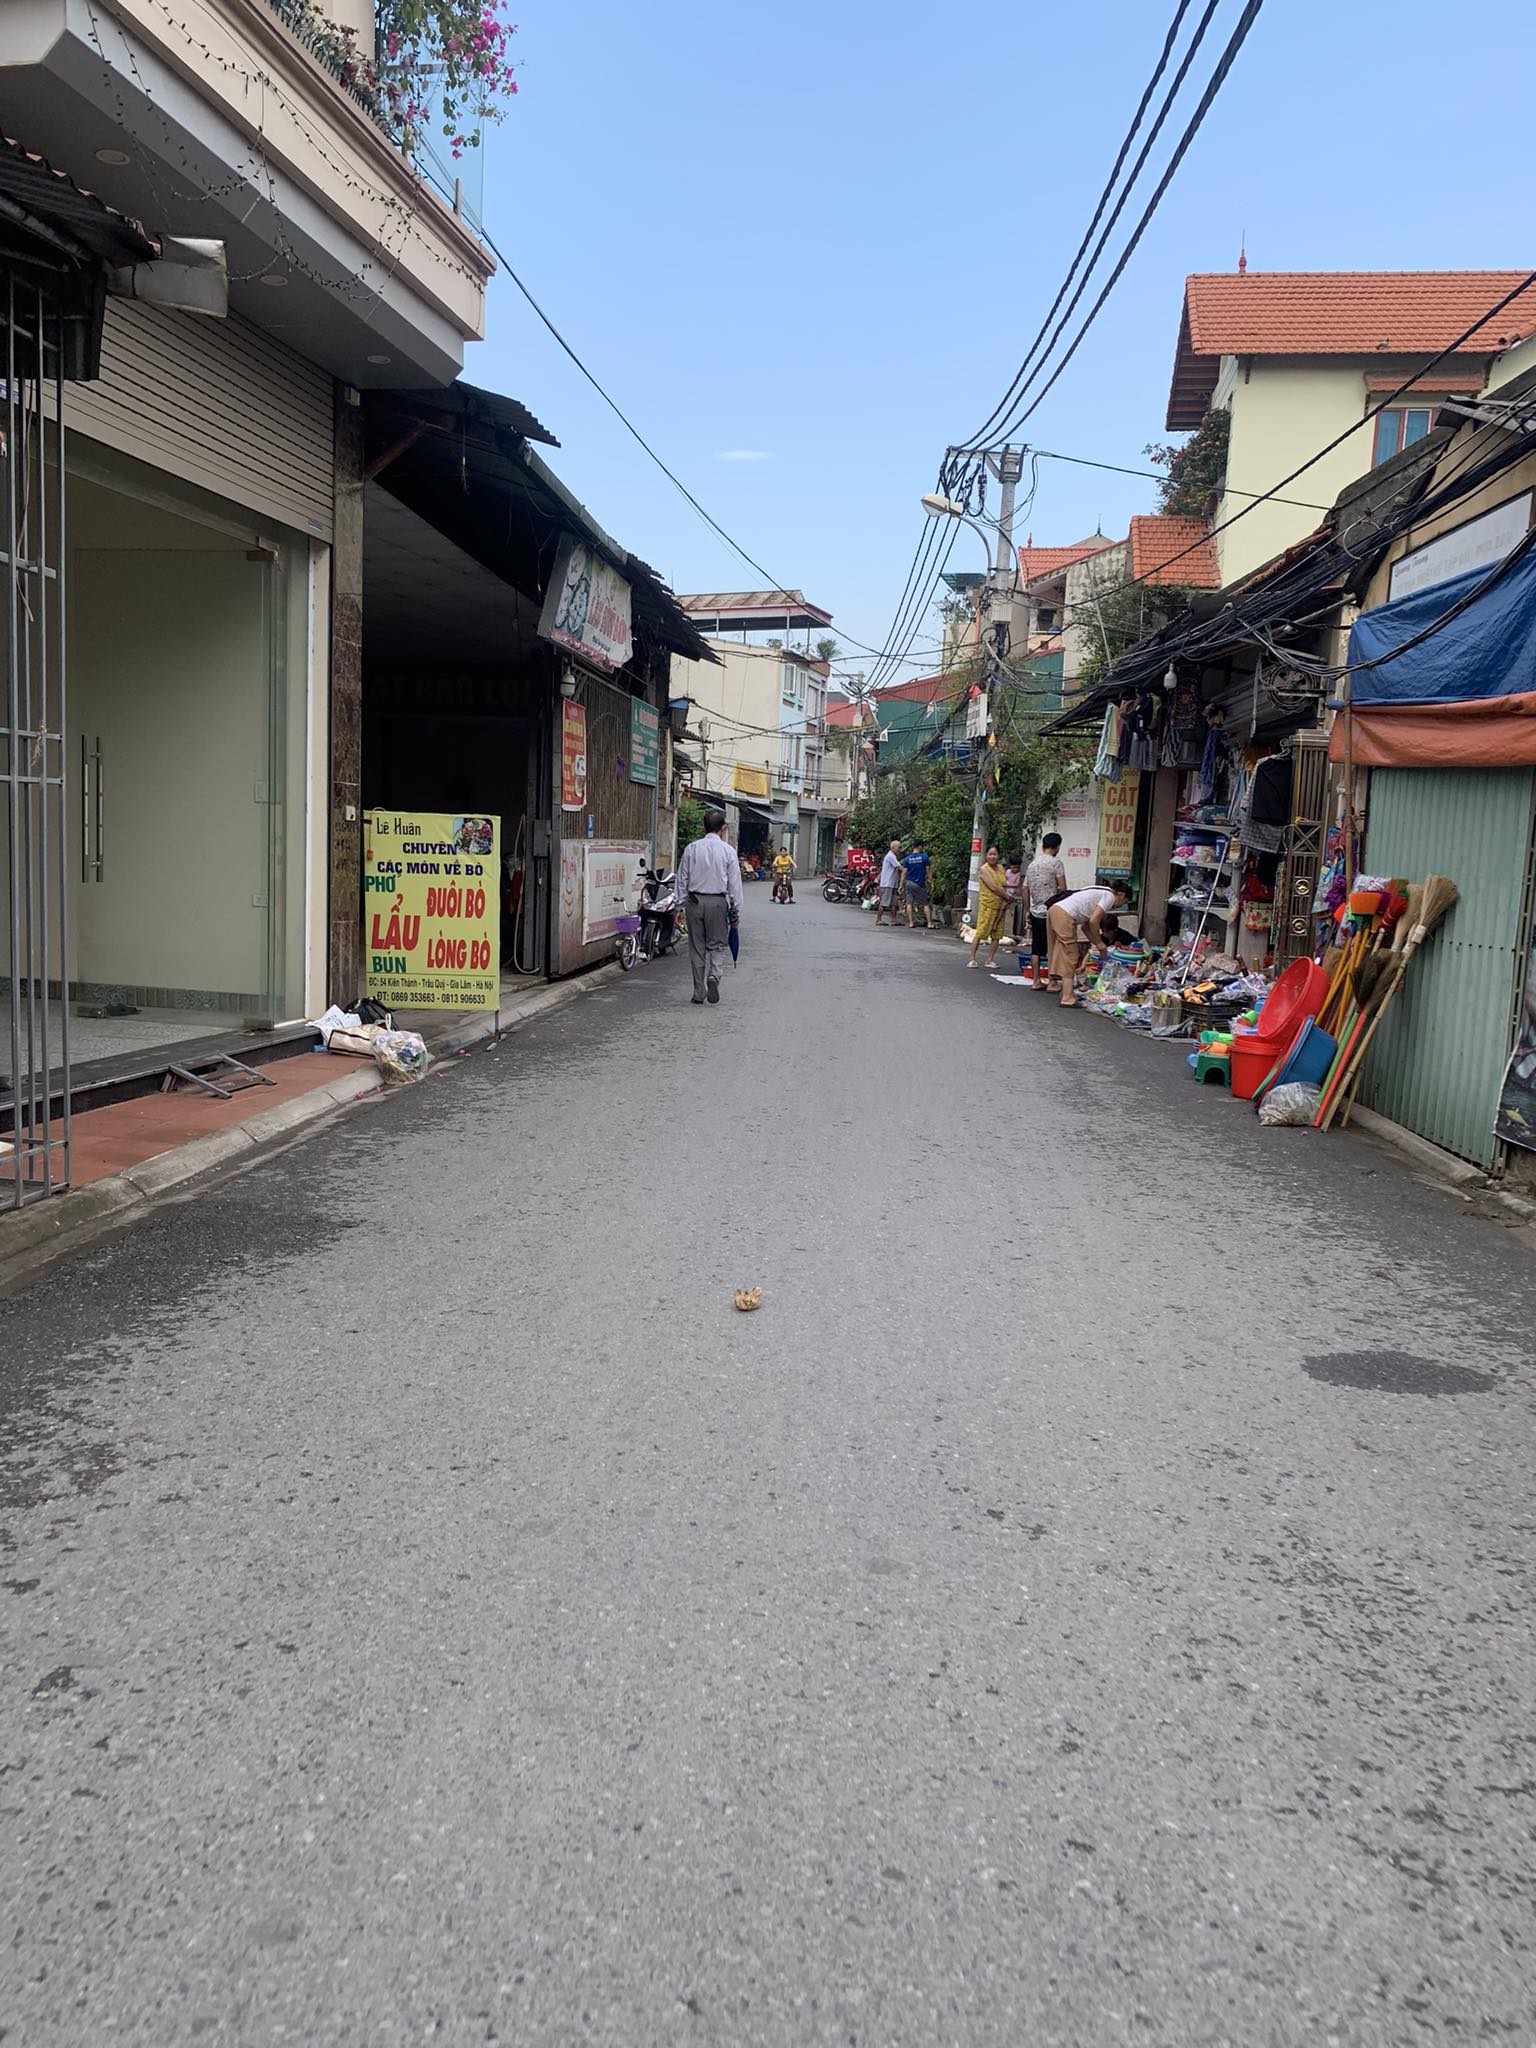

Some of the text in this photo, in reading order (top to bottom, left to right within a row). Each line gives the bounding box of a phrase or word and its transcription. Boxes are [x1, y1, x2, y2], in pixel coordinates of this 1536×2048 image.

[1106, 780, 1138, 807] CẮT
[376, 816, 421, 836] Lê Huân
[1104, 810, 1135, 833] TÓC
[402, 841, 457, 855] CHUYÊN
[1104, 837, 1129, 848] NAM
[406, 860, 440, 874] MÓN
[444, 859, 462, 875] VỀ
[465, 862, 484, 876] BÒ
[426, 880, 486, 919] ĐUÔI BÒ
[371, 893, 421, 951] LẨU
[427, 929, 491, 970] LÒNG BÒ
[372, 951, 407, 974] BÚN
